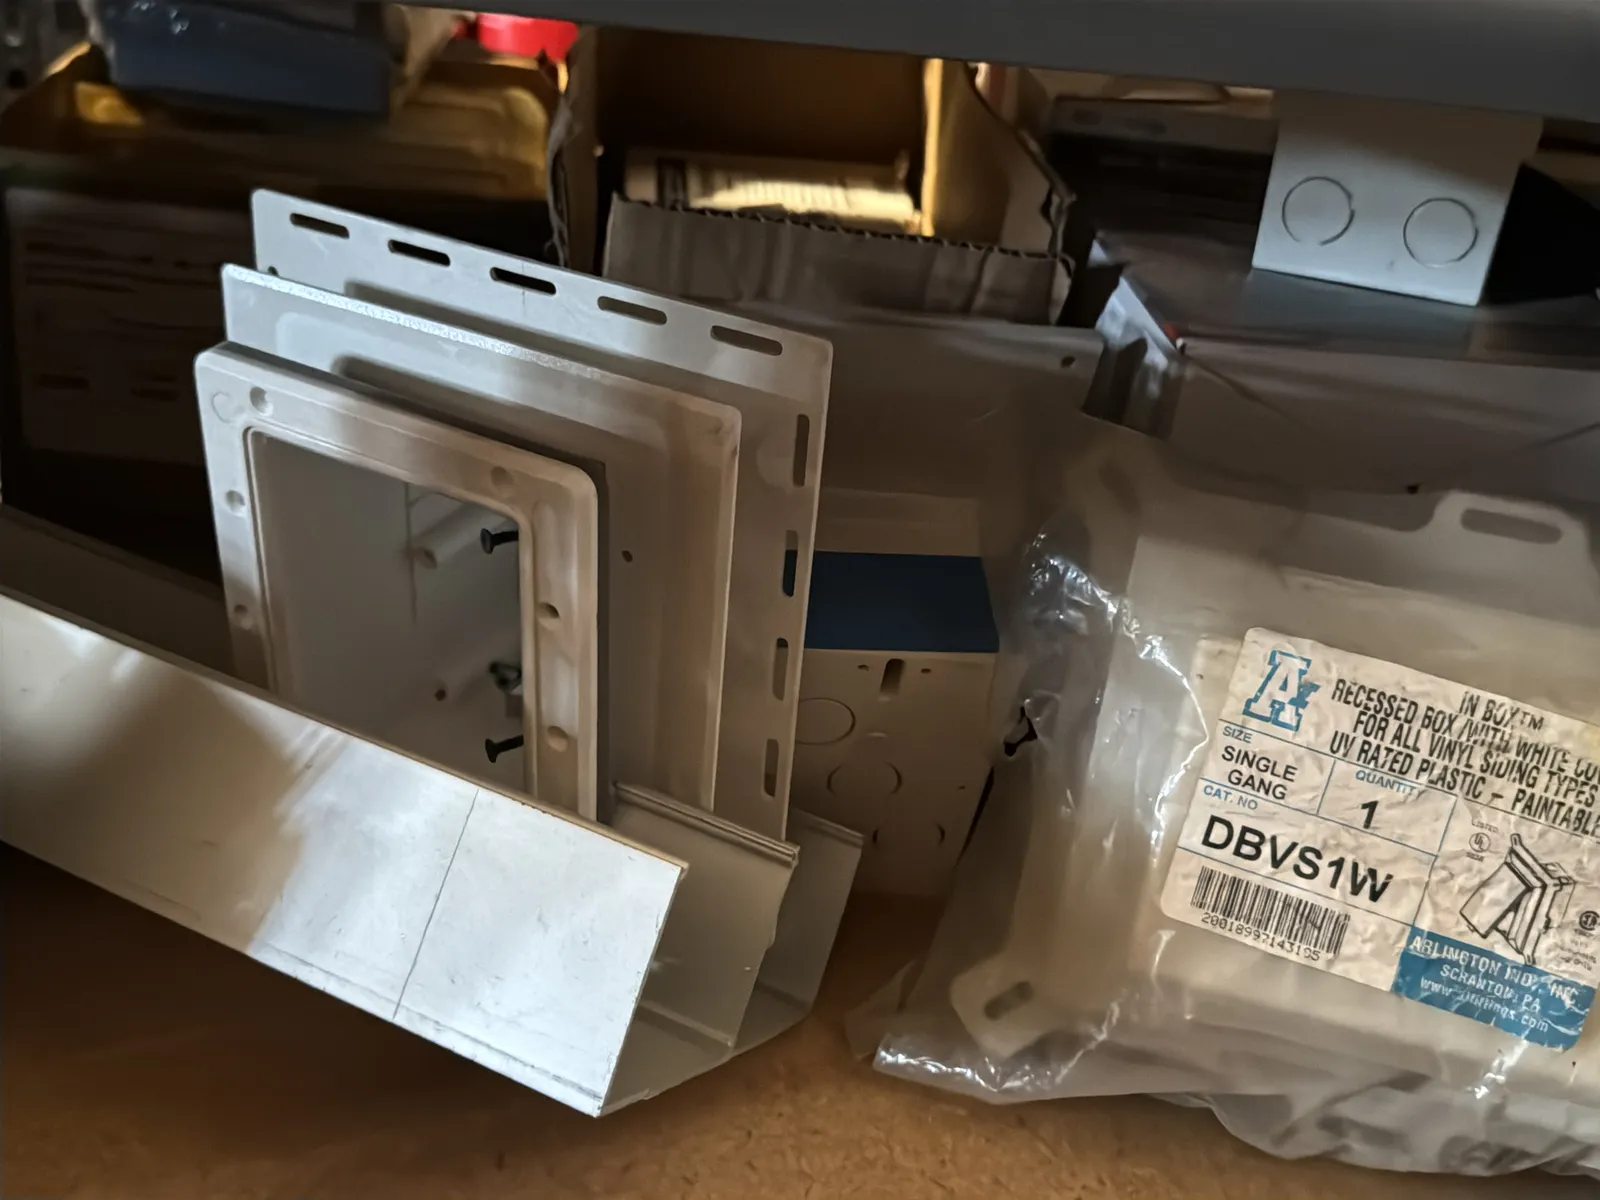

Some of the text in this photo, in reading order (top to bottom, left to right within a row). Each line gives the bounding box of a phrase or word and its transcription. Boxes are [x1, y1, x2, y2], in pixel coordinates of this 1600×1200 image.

[1459, 691, 1480, 718] IN
[1222, 725, 1253, 744] SIZE
[1331, 679, 1419, 725] RECESSED
[1421, 706, 1458, 736] BOX
[1515, 738, 1571, 774] WHITE
[1574, 758, 1600, 786] CO
[1221, 745, 1299, 782] SINGLE
[1353, 711, 1599, 808] FOR ALL VINYL SIDING TYPES
[1227, 769, 1288, 801] GANG
[1330, 730, 1356, 758] UV
[1357, 740, 1414, 776] RATED
[1416, 759, 1486, 799] PLASTIC
[1511, 788, 1600, 838] PAINTABLE
[1361, 800, 1380, 829] 1
[1201, 814, 1394, 903] DBVS1W
[1407, 935, 1502, 976] ARLINGTON
[1521, 994, 1541, 1013] PA
